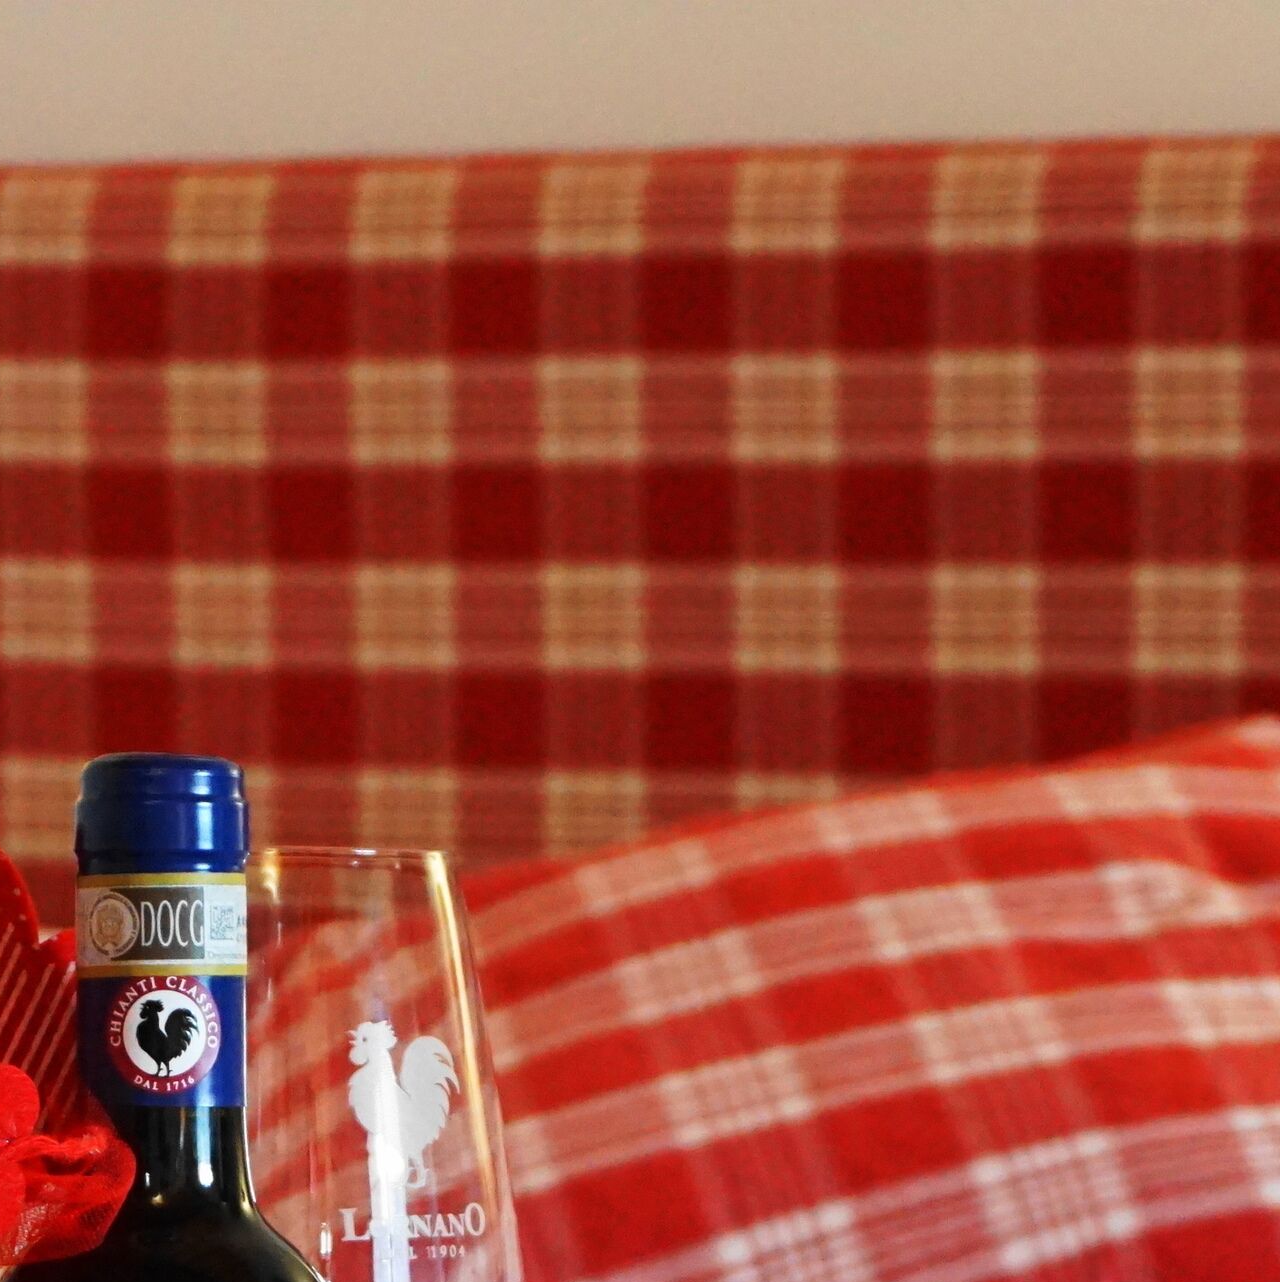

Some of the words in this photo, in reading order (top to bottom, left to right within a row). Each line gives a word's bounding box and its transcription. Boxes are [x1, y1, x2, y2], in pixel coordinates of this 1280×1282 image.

[140, 899, 204, 947] DOCG
[109, 976, 158, 1047] CHIANTI
[165, 975, 219, 1049] CLASSICO
[133, 1074, 159, 1091] DAL
[166, 1075, 196, 1092] 1716
